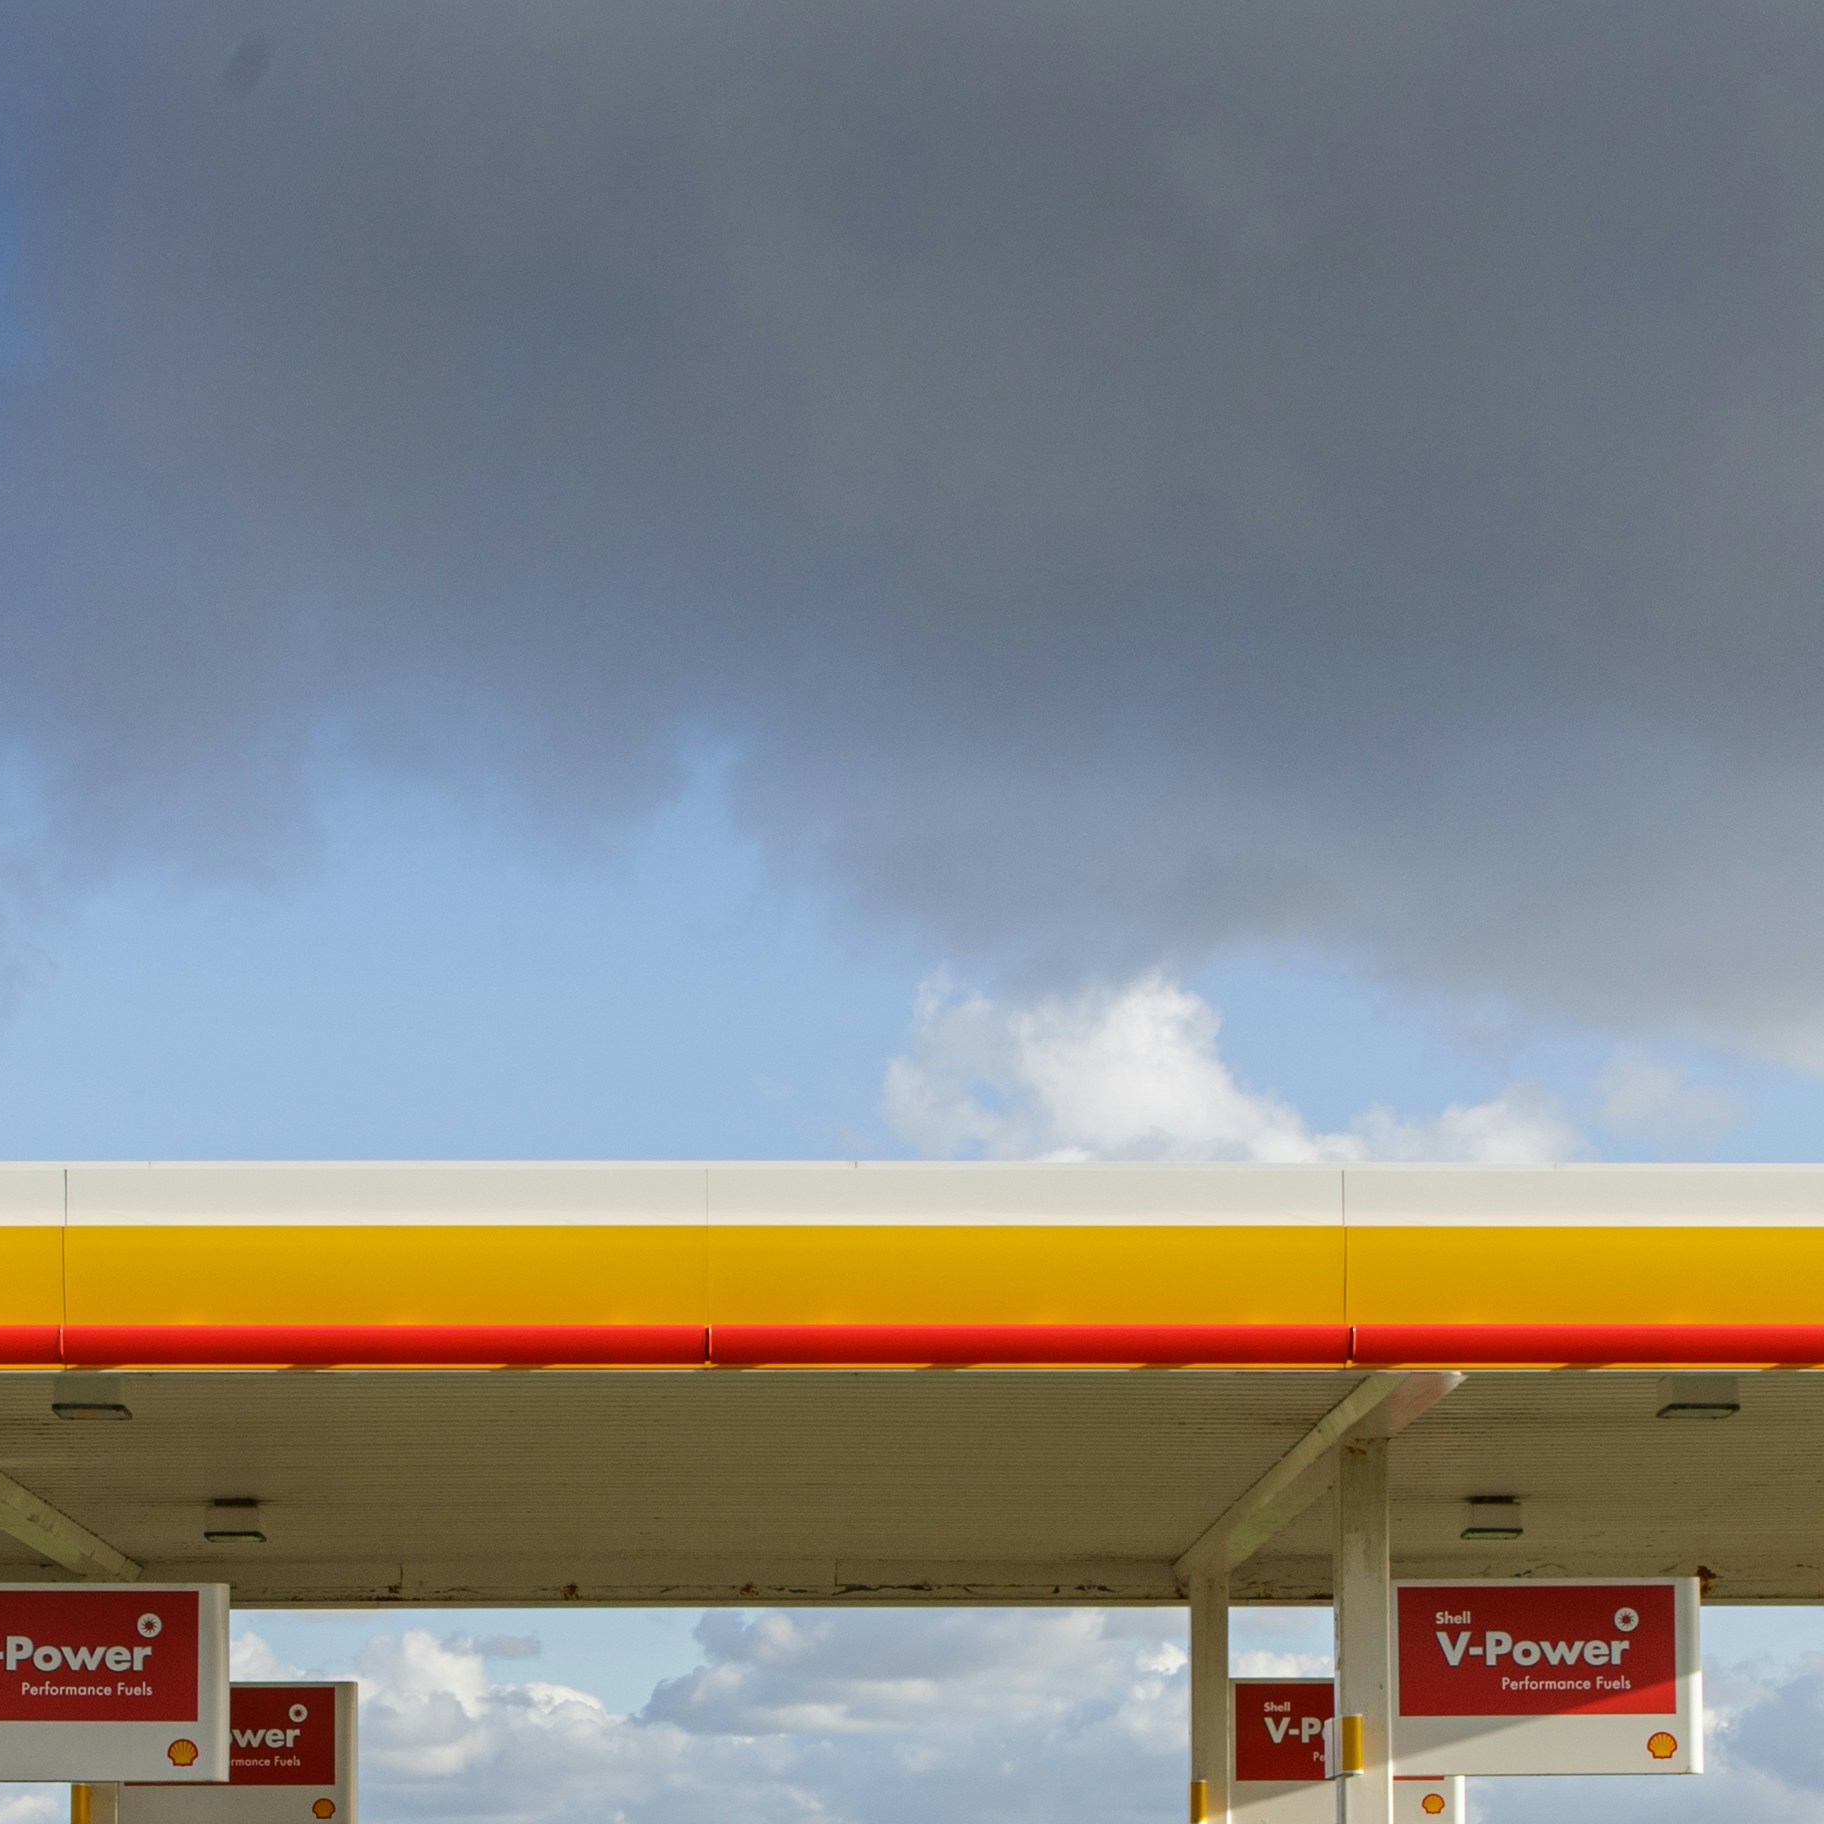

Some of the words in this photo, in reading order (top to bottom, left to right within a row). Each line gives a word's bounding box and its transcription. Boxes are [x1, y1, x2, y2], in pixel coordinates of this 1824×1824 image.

[1435, 1611, 1472, 1625] Shell
[1435, 1631, 1630, 1666] V-Power
[22, 1681, 112, 1696] Performance
[117, 1681, 153, 1696] Fuels
[1502, 1676, 1591, 1690] Performance
[1596, 1676, 1631, 1690] Fuels
[1264, 1701, 1291, 1712] Shell
[1264, 1717, 1325, 1744] V-P
[274, 1755, 301, 1766] Fuels
